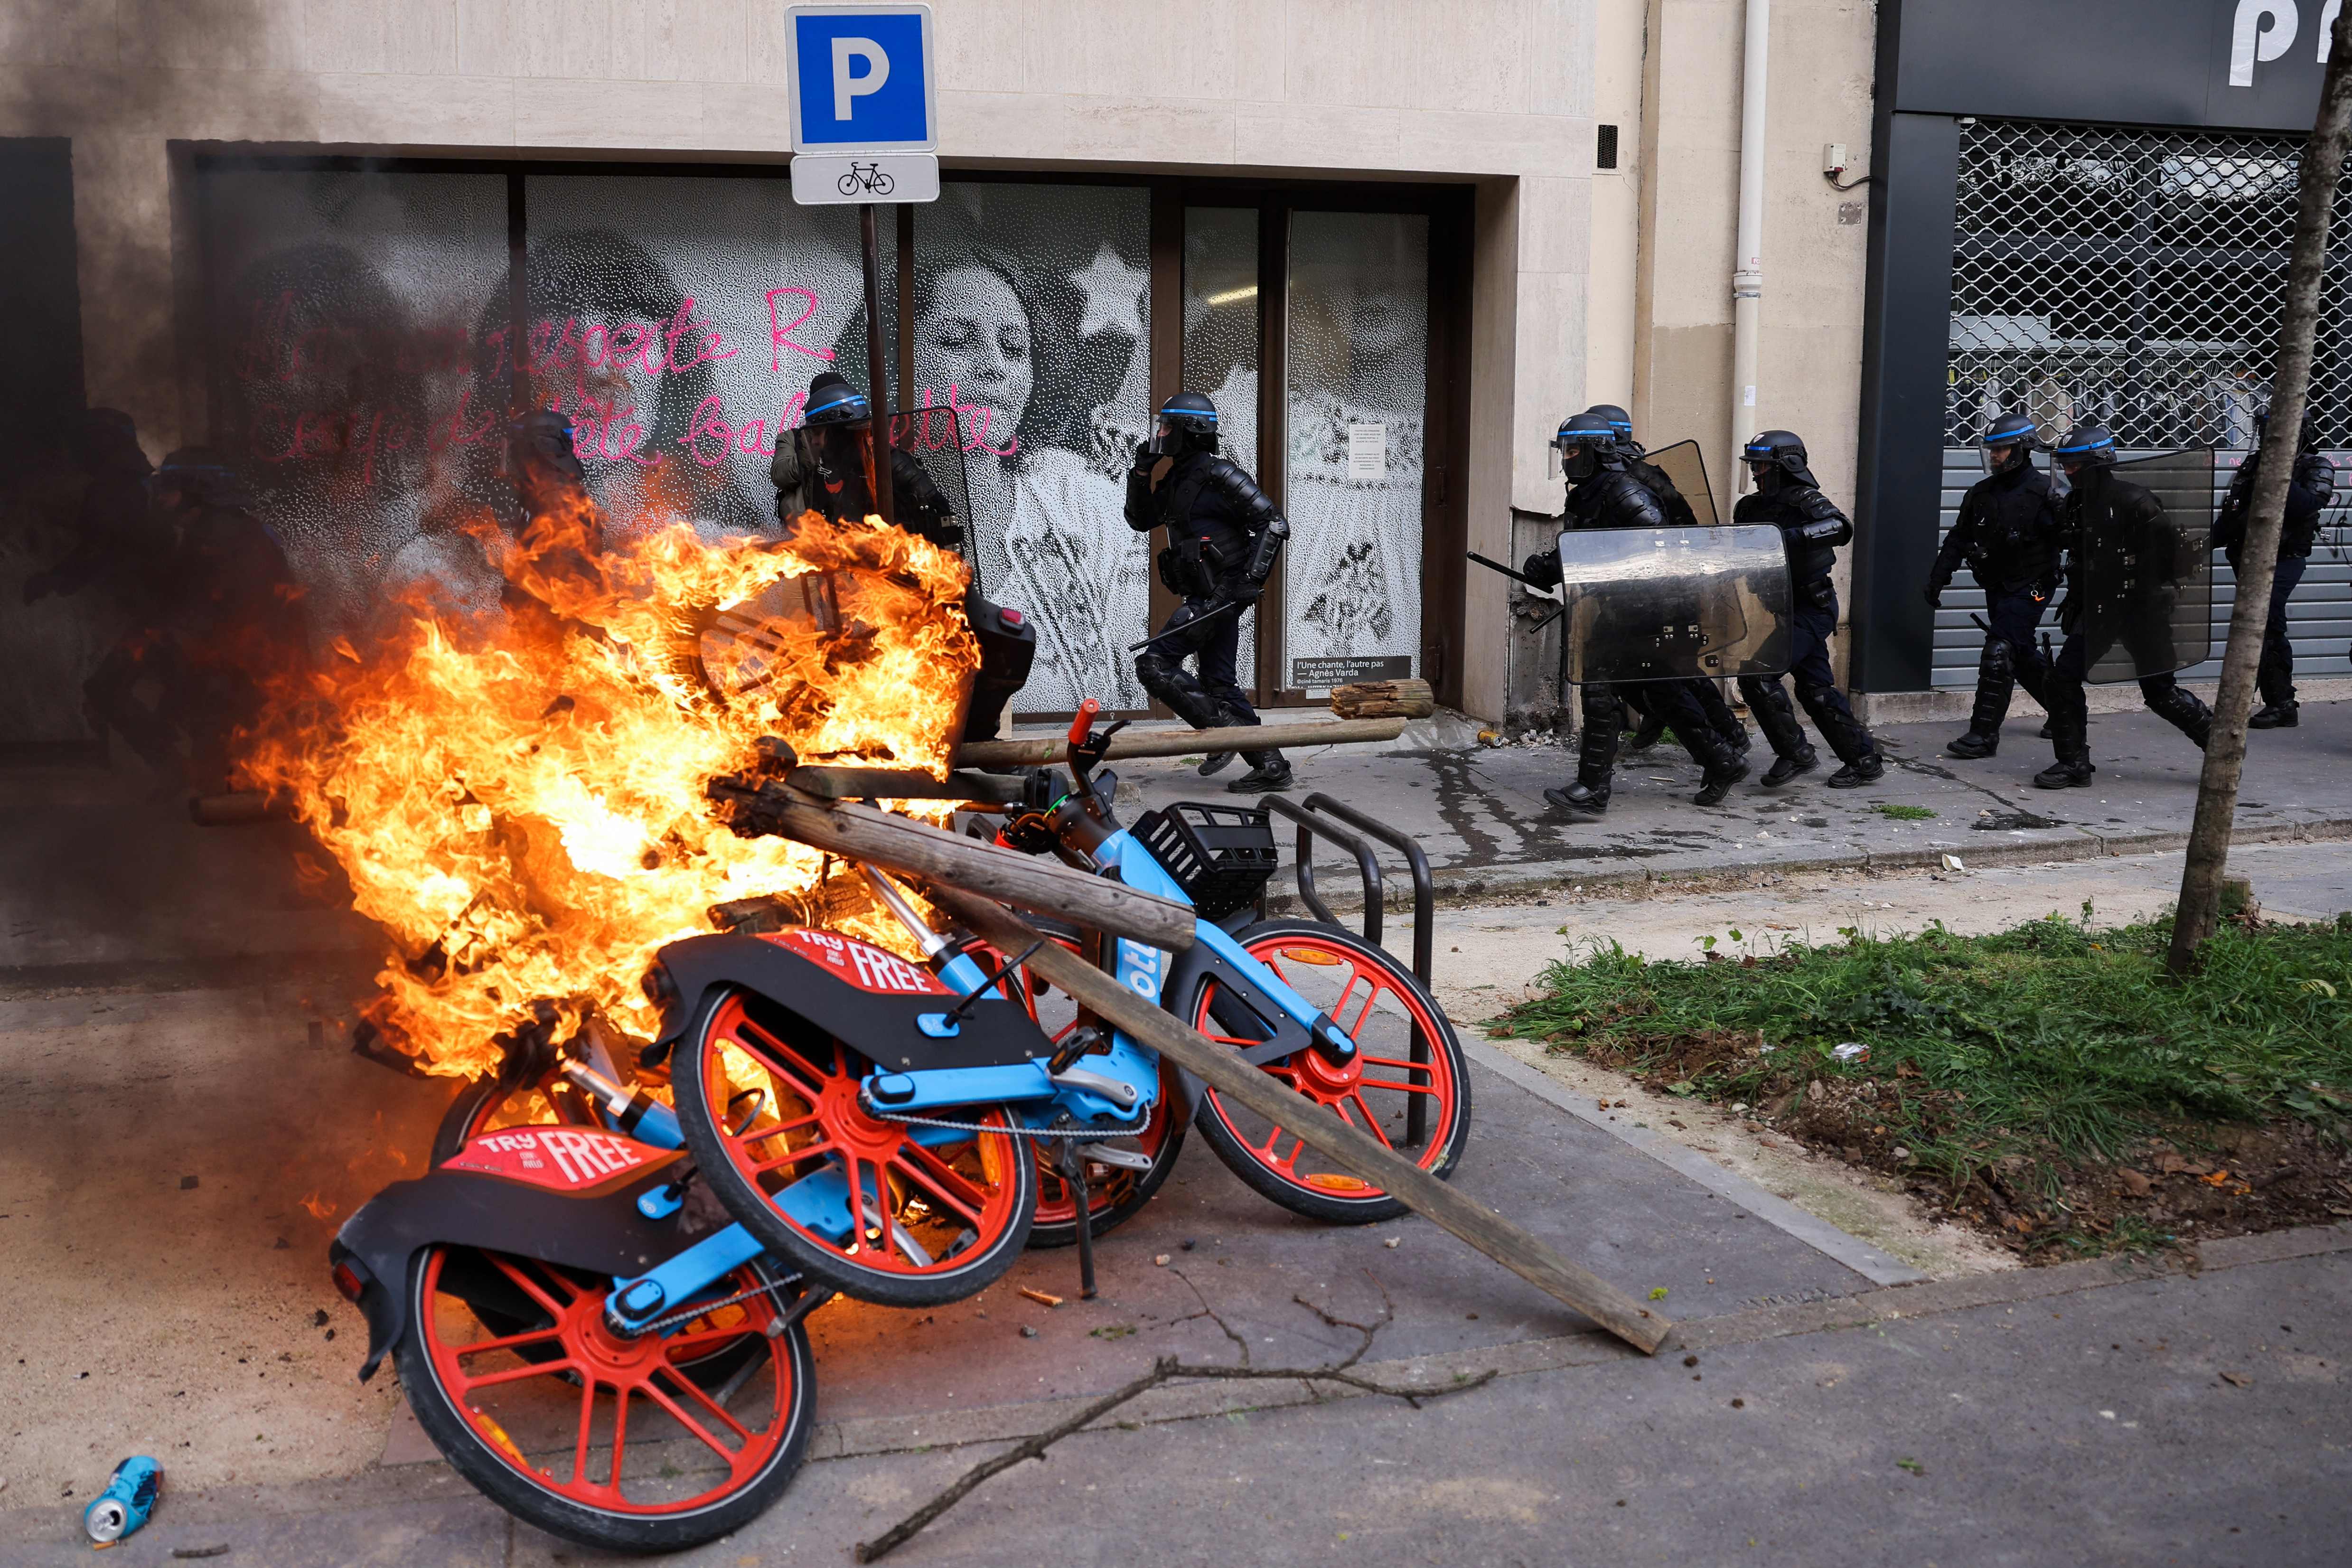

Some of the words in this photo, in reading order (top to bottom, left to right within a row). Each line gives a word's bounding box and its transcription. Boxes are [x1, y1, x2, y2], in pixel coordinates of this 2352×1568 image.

[831, 37, 890, 121] P
[547, 395, 663, 464] ête
[1308, 669, 1334, 679] Agnès
[1335, 668, 1359, 676] Varda
[1318, 661, 1345, 669] chante,
[1346, 660, 1370, 668] l'autre
[1371, 661, 1384, 669] pas
[794, 930, 844, 951] TRY
[846, 941, 932, 993] FREE
[1124, 939, 1157, 998] ott
[478, 1132, 538, 1153] TRY
[536, 1130, 642, 1183] FREE
